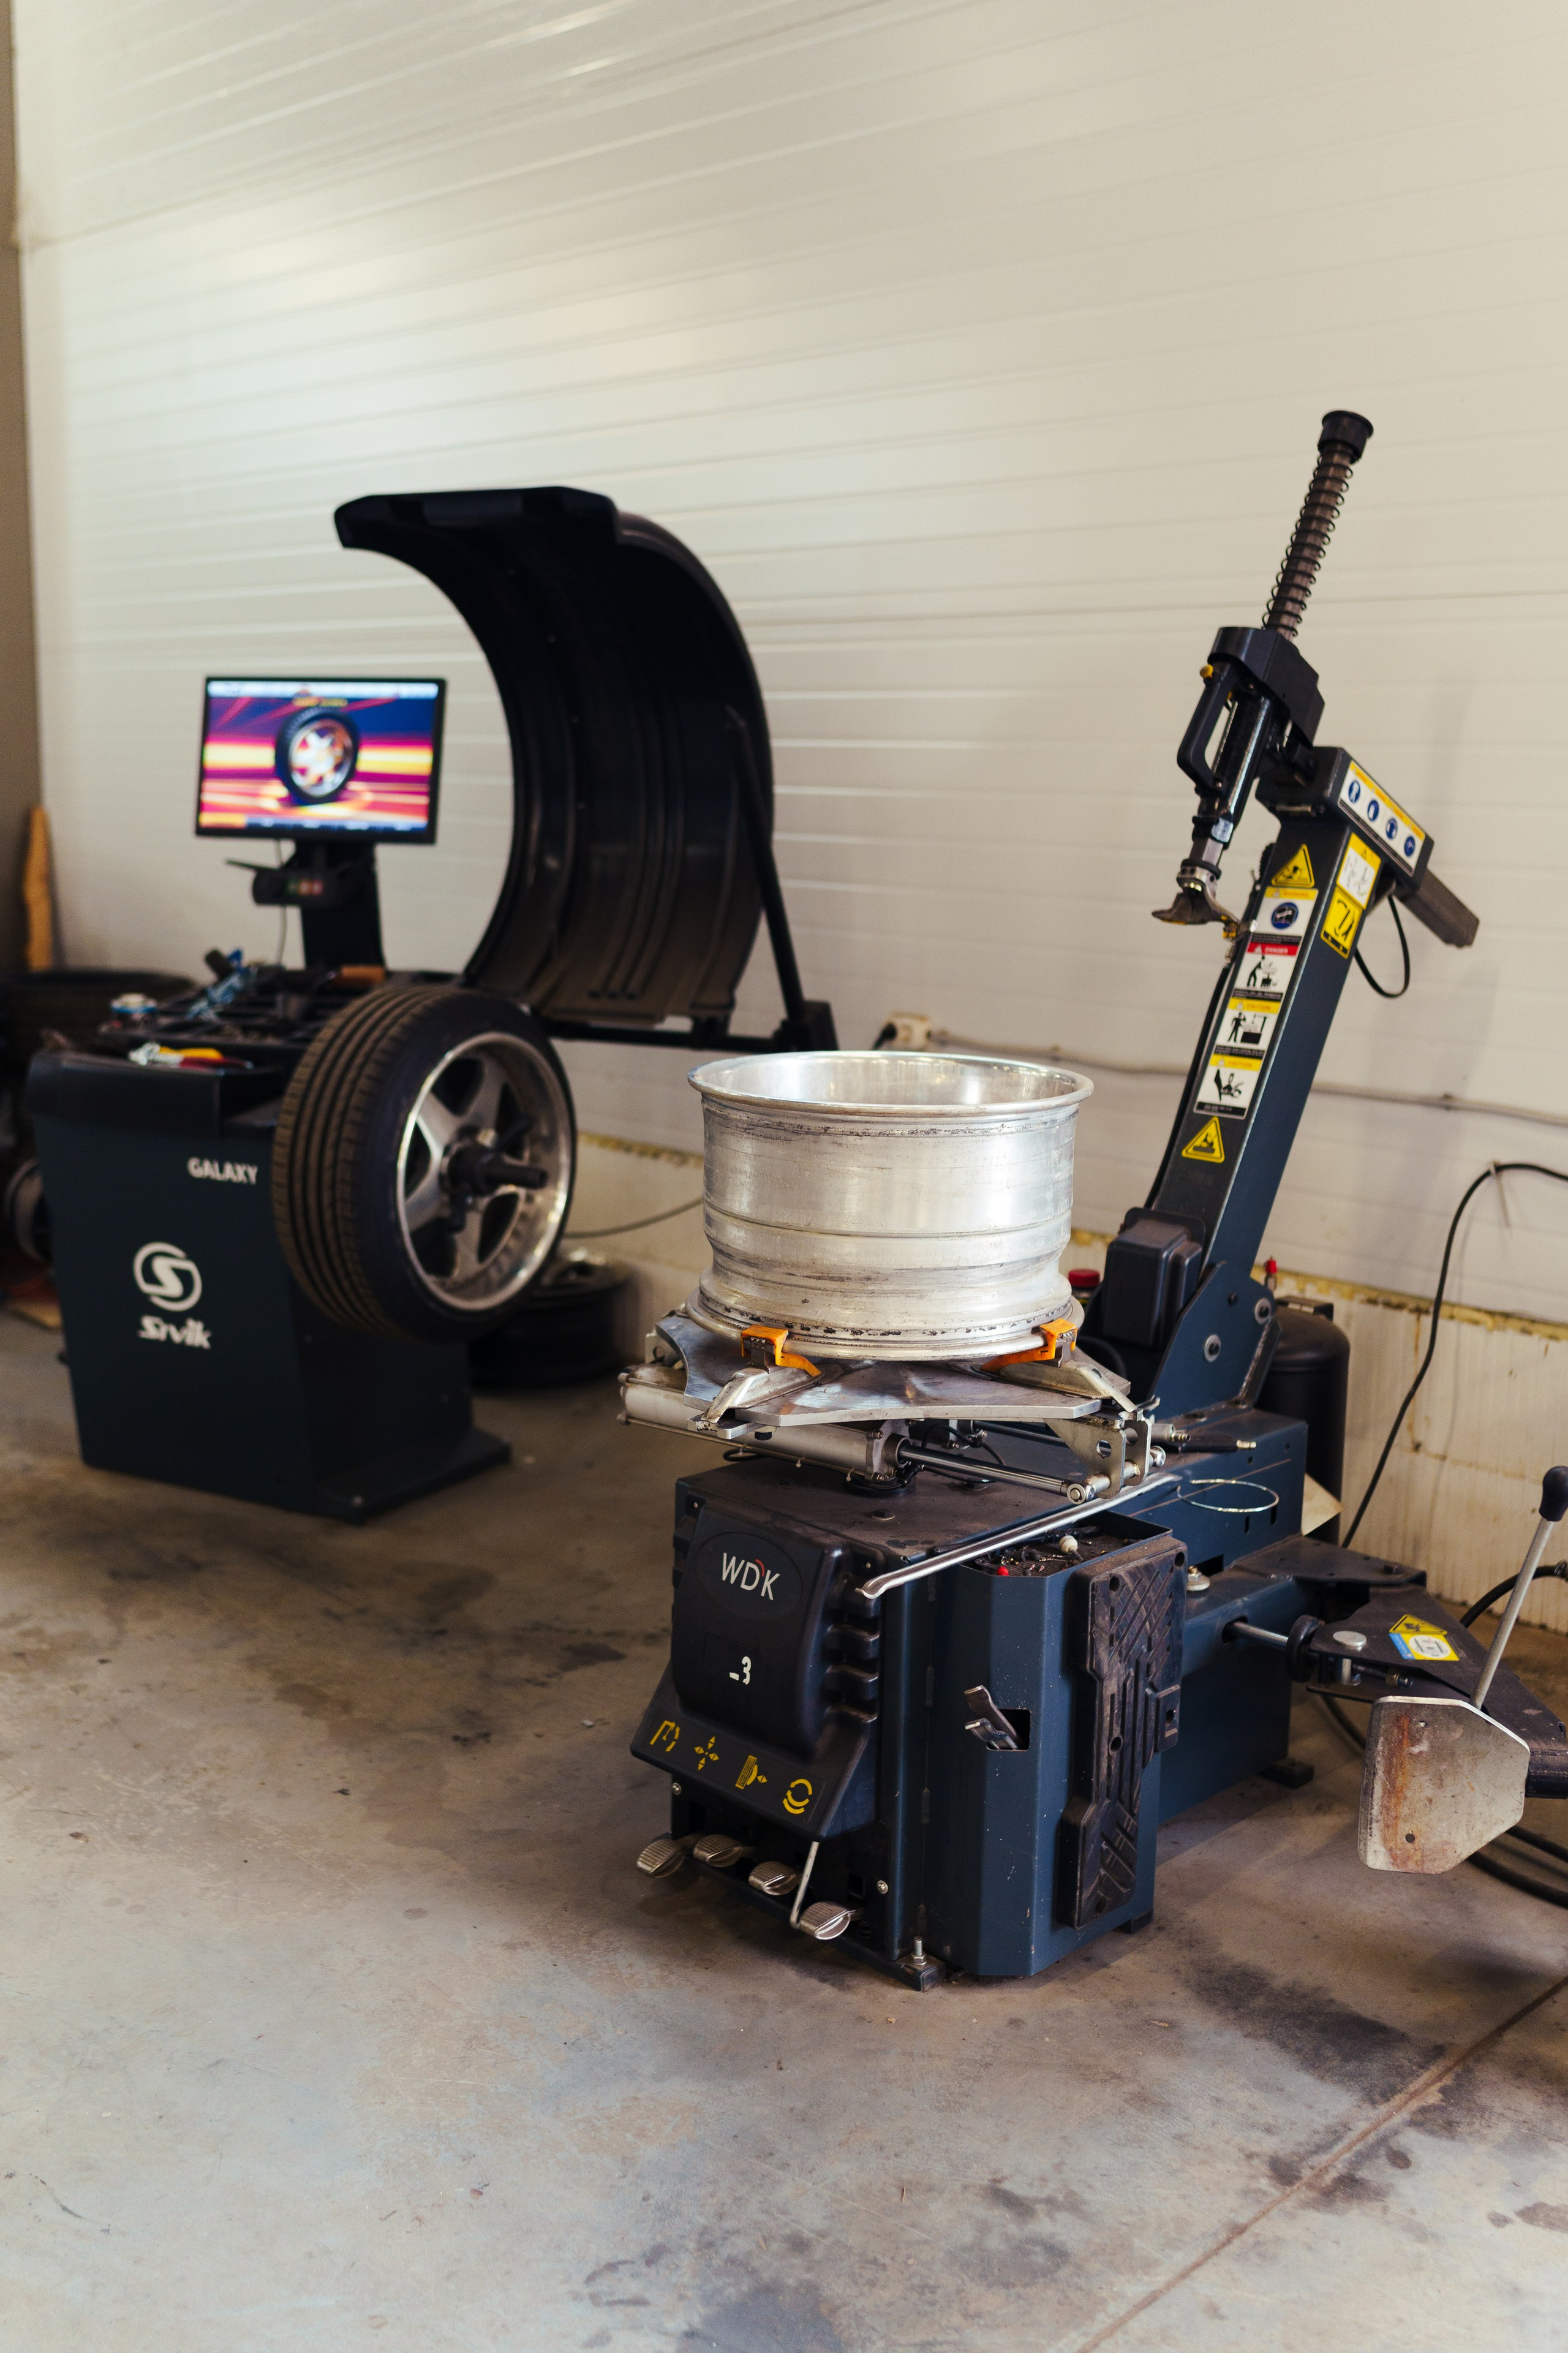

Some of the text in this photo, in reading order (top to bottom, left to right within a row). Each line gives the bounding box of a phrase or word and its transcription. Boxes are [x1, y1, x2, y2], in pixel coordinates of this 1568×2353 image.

[1264, 945, 1289, 954] DANGER
[187, 1157, 258, 1184] GALAXY
[722, 1552, 780, 1601] WDK
